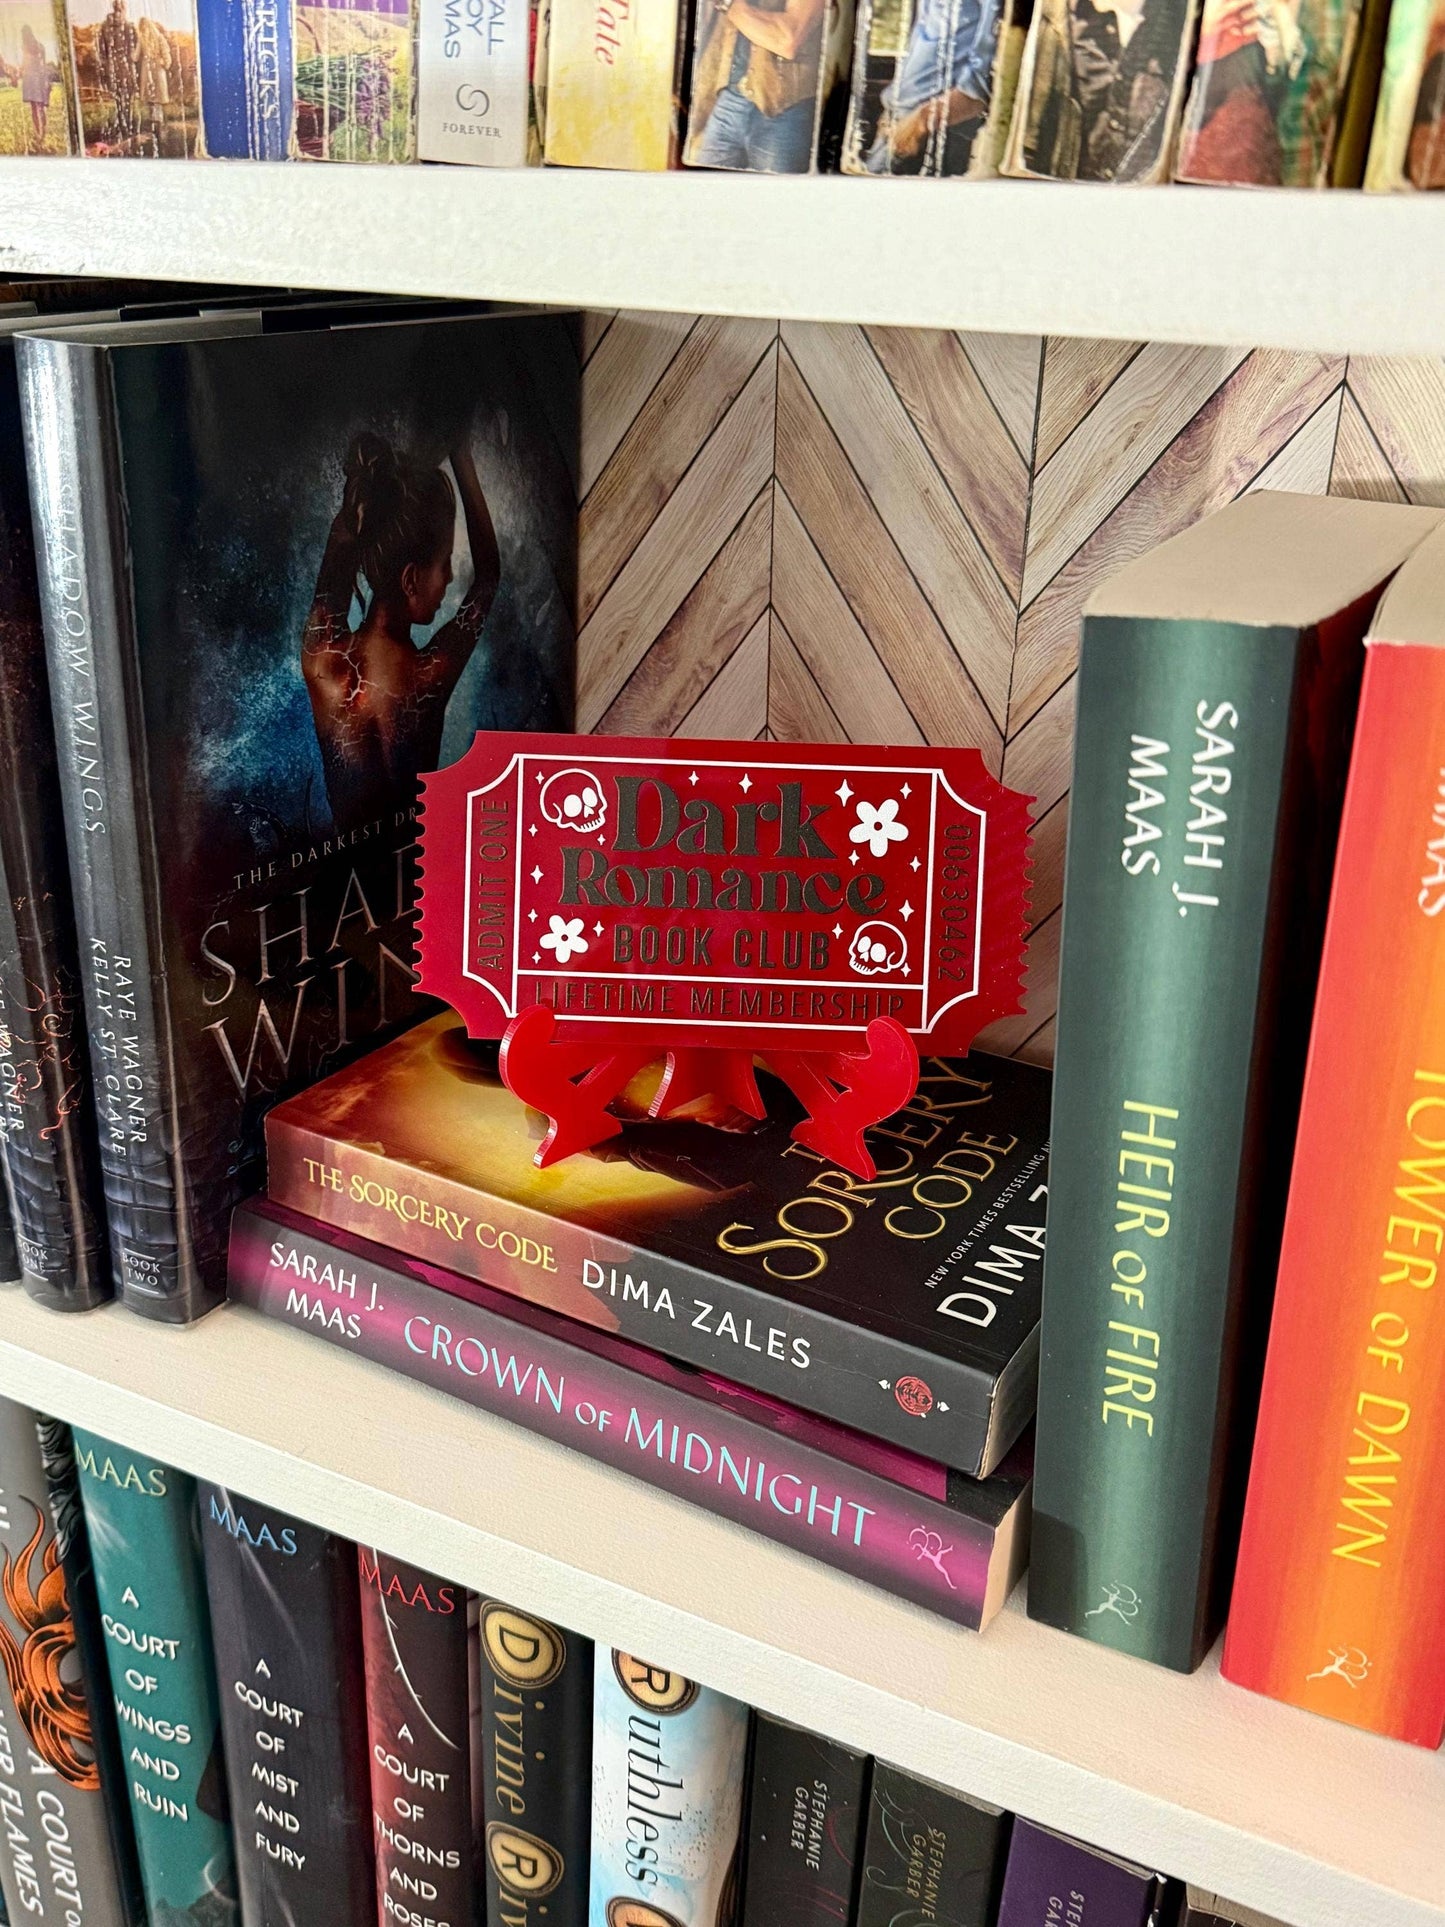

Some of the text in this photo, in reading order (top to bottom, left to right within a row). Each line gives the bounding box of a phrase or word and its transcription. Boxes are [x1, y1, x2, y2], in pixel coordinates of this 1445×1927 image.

[488, 0, 505, 55] ALL
[250, 0, 279, 120] RICKS
[442, 122, 502, 138] FOREVER
[71, 702, 106, 834] WINGS
[611, 776, 838, 860] Dark
[1121, 733, 1171, 876] MAAS
[1172, 699, 1239, 917] SARAH J.
[233, 806, 418, 890] THE DARKEST DR
[477, 800, 509, 971] ADMIT ONE
[558, 846, 887, 916] Romance
[938, 824, 973, 982] 00630462
[613, 923, 831, 971] BOOK CLUB
[200, 942, 421, 1104] WIN
[534, 980, 905, 1021] LIFETIME MEMBERSHIP
[89, 937, 114, 1020] KELLY
[105, 1074, 127, 1158] CLARE
[112, 954, 149, 1144] RAYE WAGNER
[884, 1131, 1018, 1239] CODE
[924, 1265, 949, 1289] NEW
[945, 1239, 974, 1265] YORK
[968, 1209, 998, 1238] TIMES
[992, 1153, 1046, 1209] BESTSELLING
[121, 1252, 161, 1273] BOOK
[126, 1267, 158, 1286] TWO
[269, 1242, 384, 1311] SARAH J.
[303, 1157, 812, 1369] THE SORCERY CODE DIMA ZALES
[936, 1224, 1047, 1328] DIMA
[1101, 1100, 1180, 1438] HEIR OF FIRE
[285, 1287, 362, 1338] MAAS
[1366, 1311, 1411, 1375] OF
[403, 1316, 877, 1546] CROWN OF MIDNIGHT
[74, 1439, 167, 1497] MAAS
[1331, 1390, 1412, 1568] DAWN
[210, 1495, 298, 1555] MAAS
[121, 1586, 139, 1609] A
[360, 1553, 456, 1615] MAAS
[101, 1614, 180, 1661] COURT
[255, 1658, 272, 1679] A
[125, 1669, 158, 1695] OF
[234, 1681, 304, 1728] COURT
[114, 1694, 192, 1745] WINGS
[255, 1731, 286, 1755] OF
[397, 1723, 414, 1744] A
[130, 1746, 180, 1781] AND
[252, 1762, 300, 1798] MIST
[374, 1744, 450, 1792] COURT
[133, 1781, 189, 1822] RUIN
[254, 1800, 300, 1834] AND
[393, 1797, 425, 1823] OF
[790, 1786, 810, 1850] GARBER
[805, 1779, 828, 1871] STEPHANIE
[0, 1782, 44, 1917] FLAMES
[27, 1747, 83, 1927] A COURT O
[255, 1832, 306, 1871] FURY
[374, 1811, 461, 1869] THORNS
[906, 1834, 927, 1898] GARBER
[390, 1866, 438, 1901] AND
[921, 1828, 947, 1920] STEPHANIE
